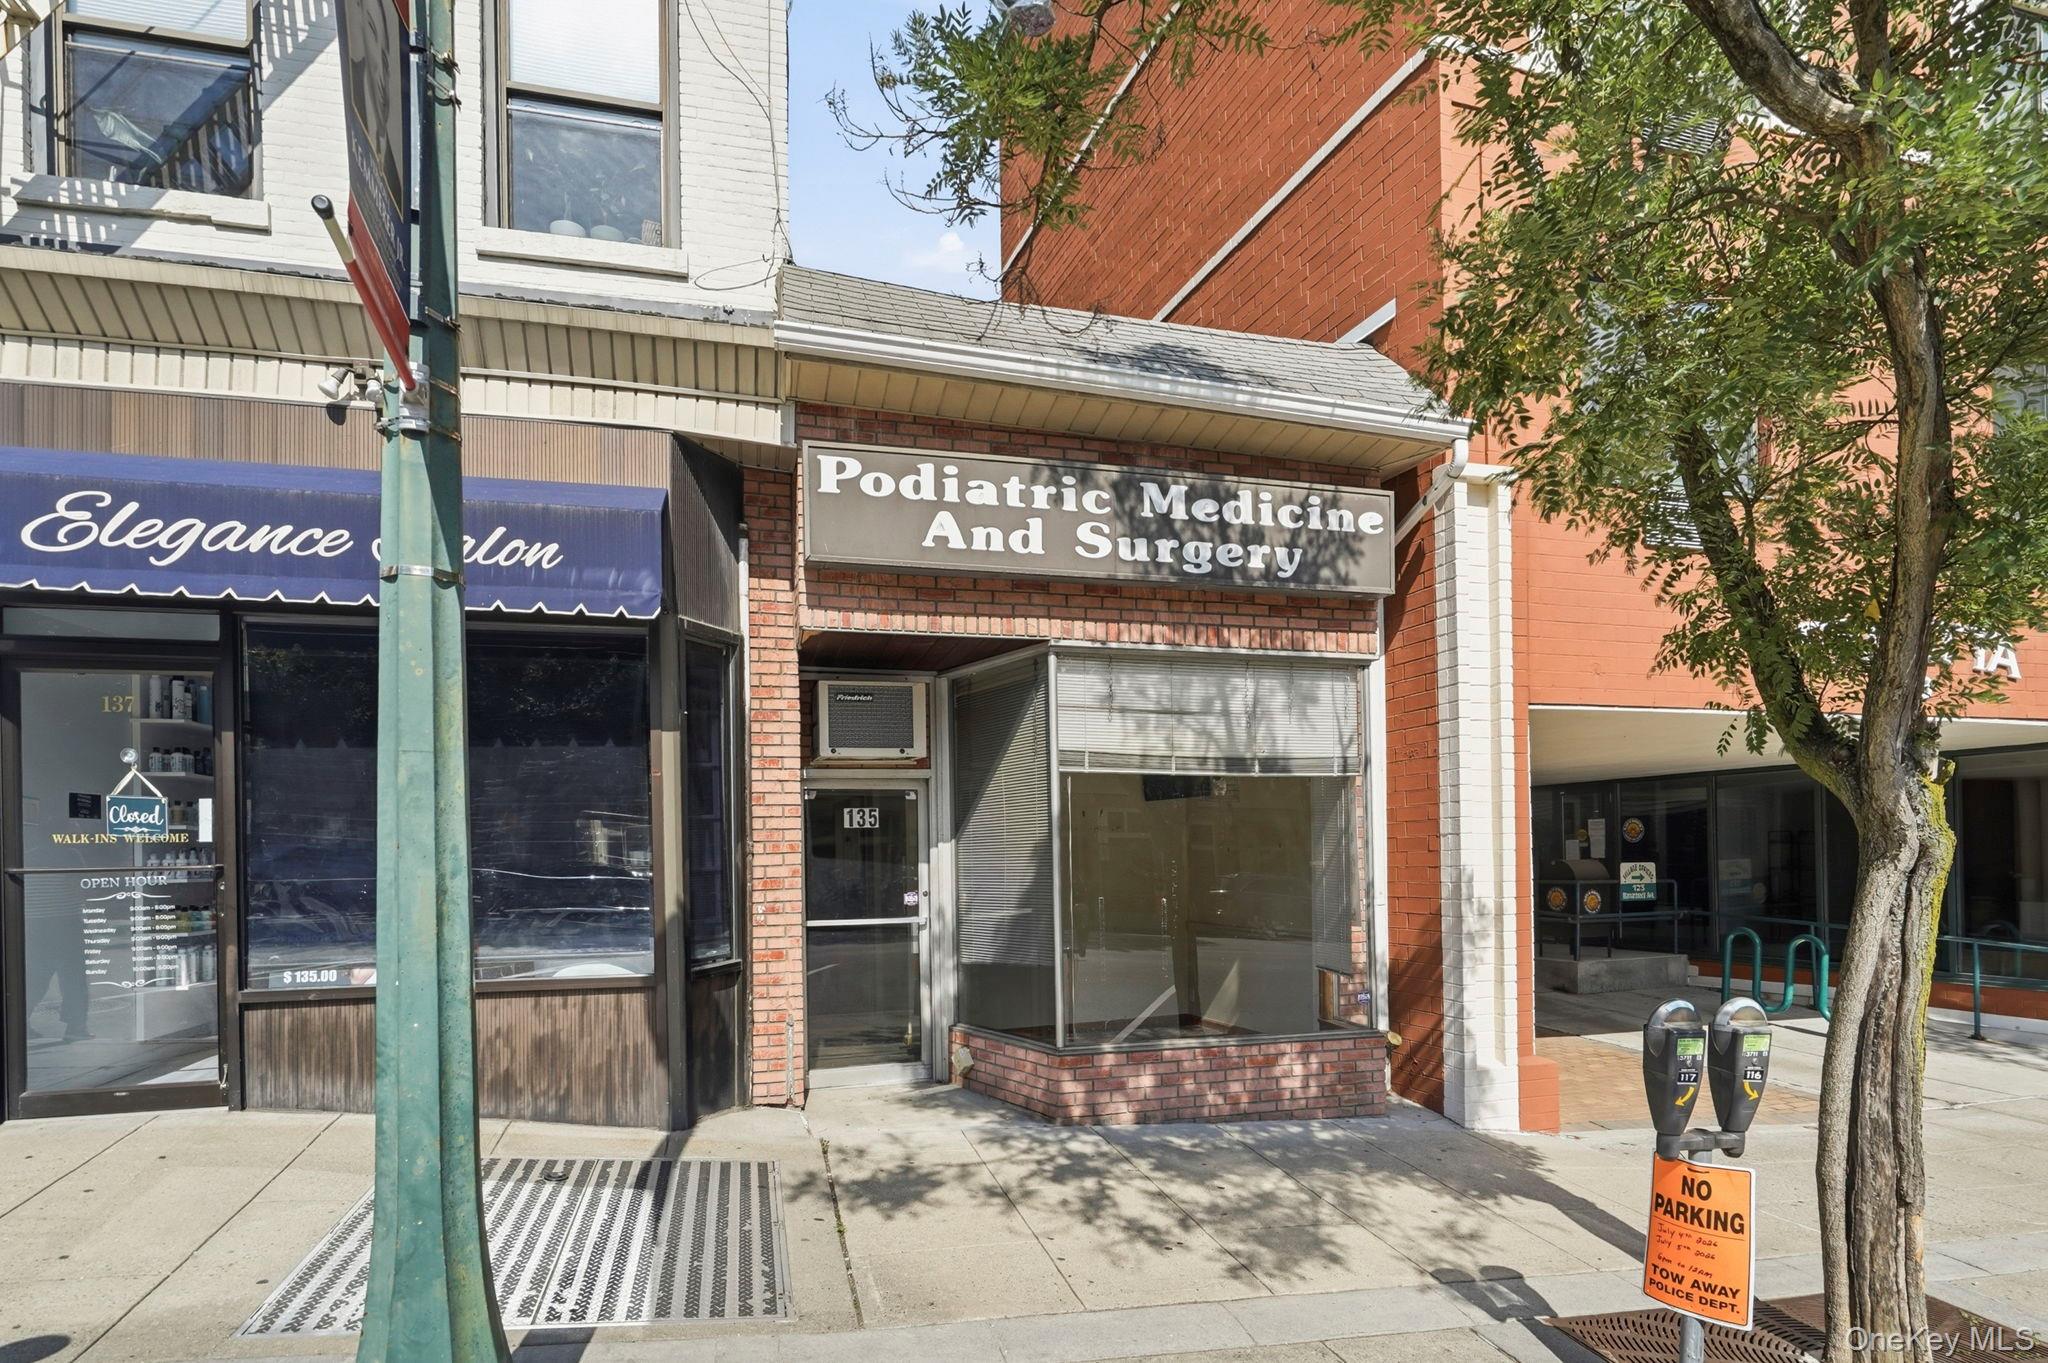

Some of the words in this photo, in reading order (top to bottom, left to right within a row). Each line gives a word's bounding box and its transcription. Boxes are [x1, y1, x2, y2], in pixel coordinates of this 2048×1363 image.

[817, 454, 1112, 514] Podiatric
[1139, 482, 1384, 534] Medicine
[20, 490, 354, 566] Elegance
[921, 510, 1045, 554] And
[1075, 521, 1303, 578] Surgery
[102, 696, 135, 712] 137
[109, 805, 164, 825] Closed
[846, 808, 878, 828] 135
[52, 833, 117, 844] WALK-INS
[123, 833, 189, 844] WELCOME
[80, 877, 120, 889] OPEN
[125, 875, 167, 887] HOUR
[283, 971, 292, 984] $
[295, 970, 337, 983] 135.00
[1746, 1071, 1761, 1079] 116
[1681, 1175, 1712, 1201] NO
[1654, 1192, 1745, 1235] PARKING
[1658, 1223, 1675, 1238] July
[1656, 1234, 1671, 1248] July
[1651, 1263, 1685, 1285] TOW
[1690, 1278, 1741, 1299] AWAY
[1649, 1277, 1694, 1302] POLICE
[1699, 1295, 1740, 1314] DEPT.
